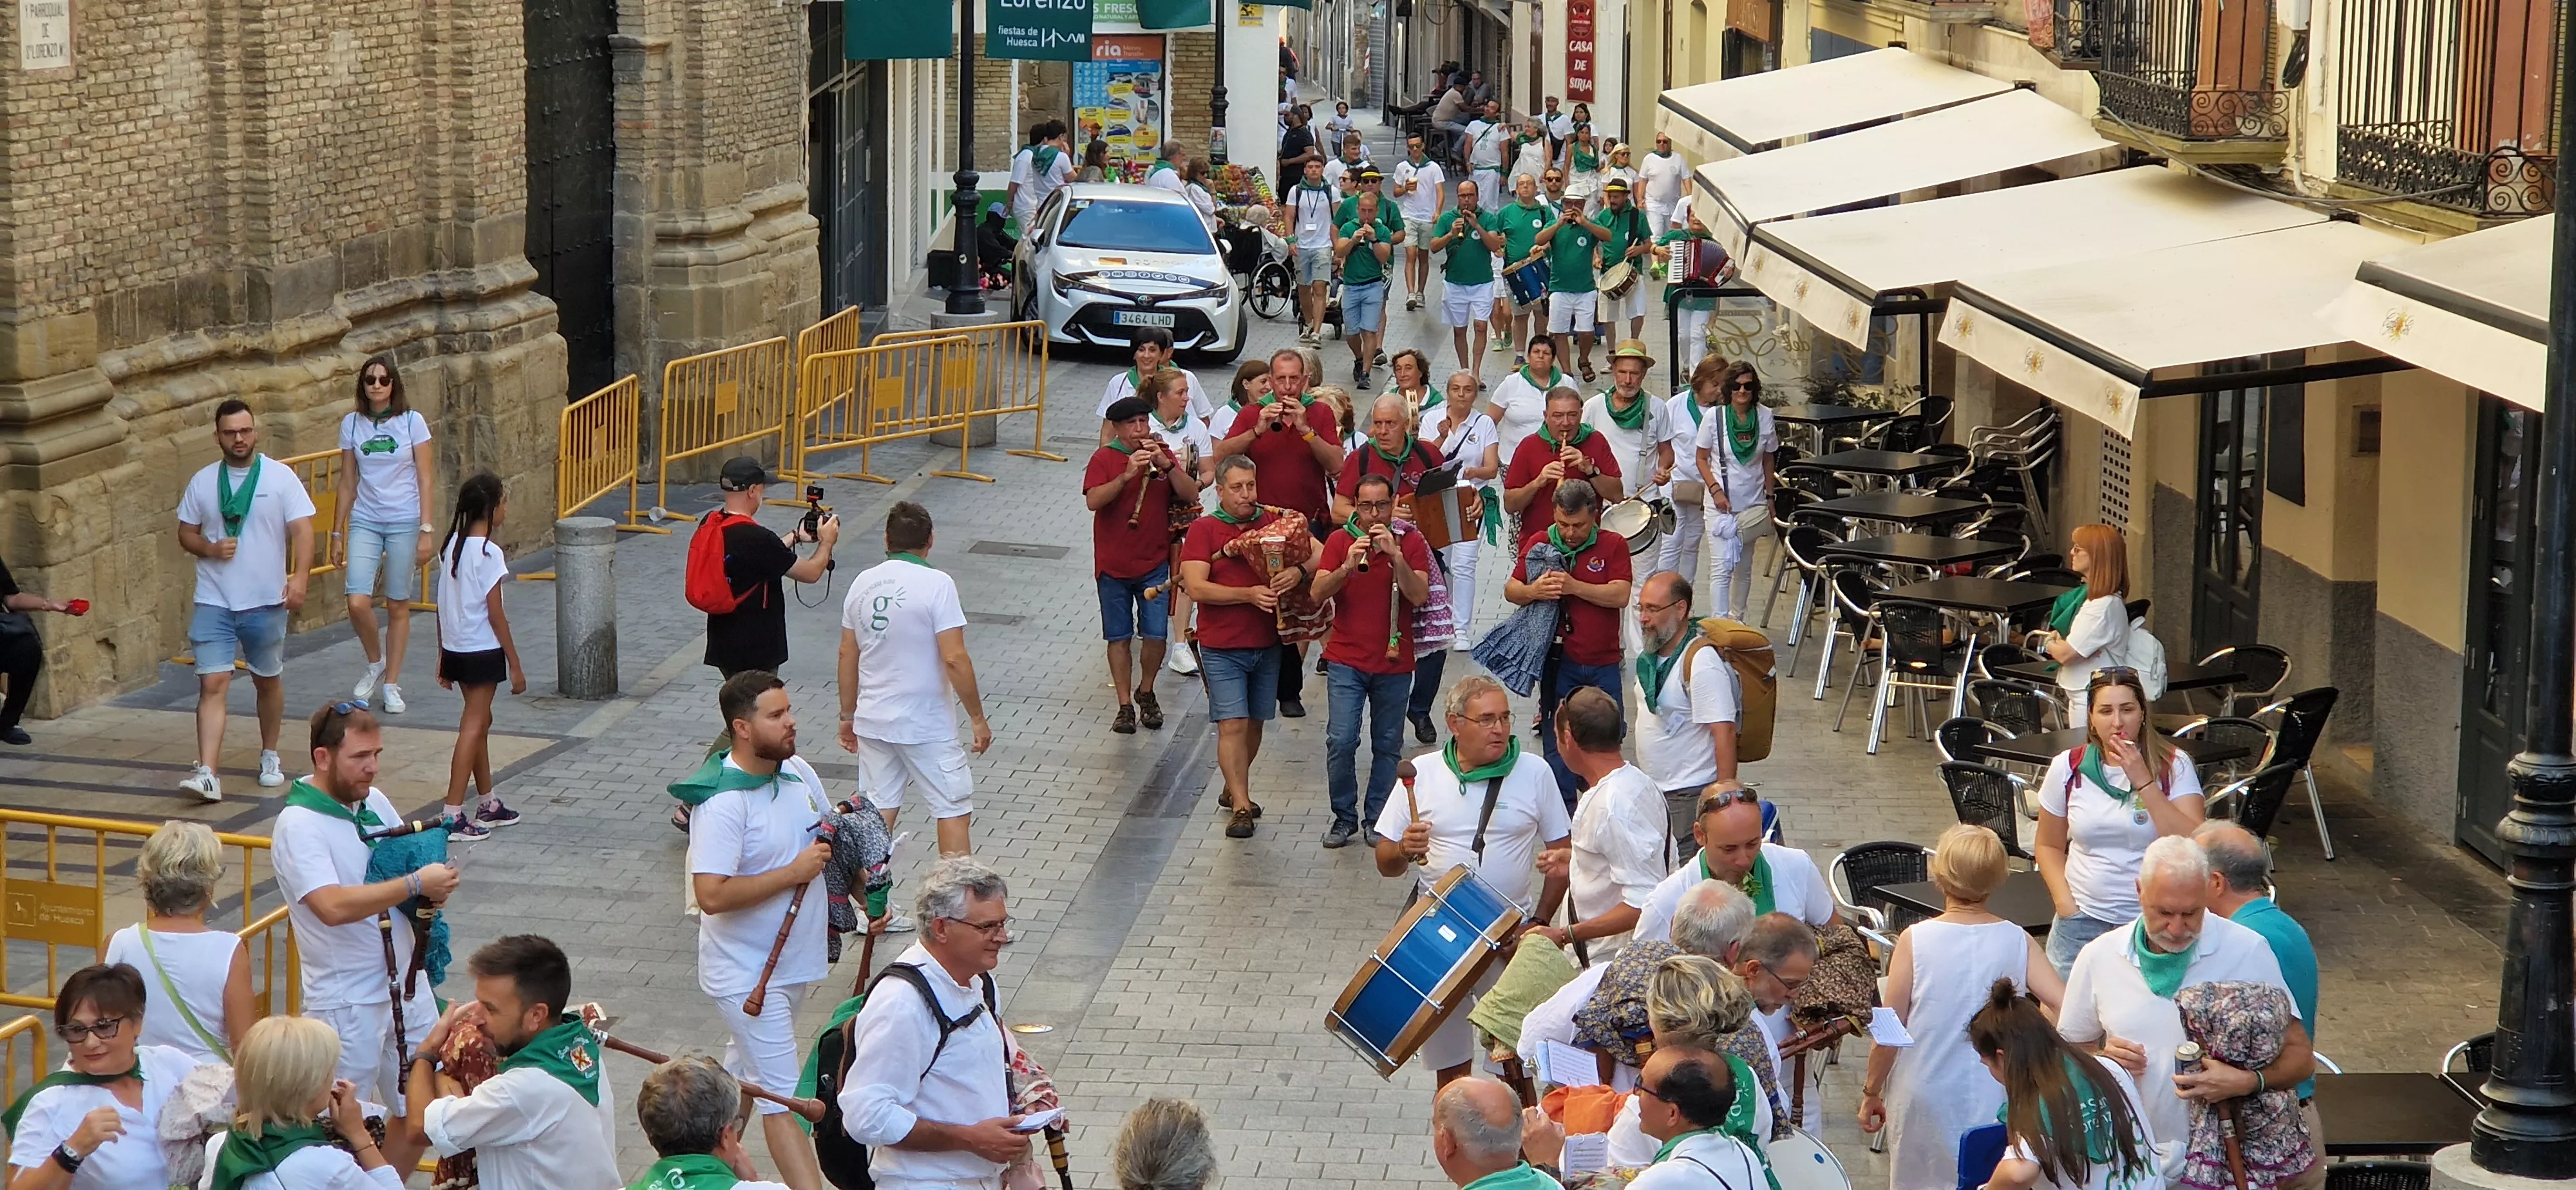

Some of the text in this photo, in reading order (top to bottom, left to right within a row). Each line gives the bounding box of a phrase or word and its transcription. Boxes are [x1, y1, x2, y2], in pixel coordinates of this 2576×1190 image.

[998, 25, 1038, 35] fiestas de
[1006, 36, 1038, 47] Huesca
[1096, 40, 1121, 56] ria
[1569, 40, 1593, 53] CASA
[1574, 59, 1587, 71] DE
[1569, 77, 1593, 92] SIRIA
[1121, 313, 1171, 326] 3464 LHD
